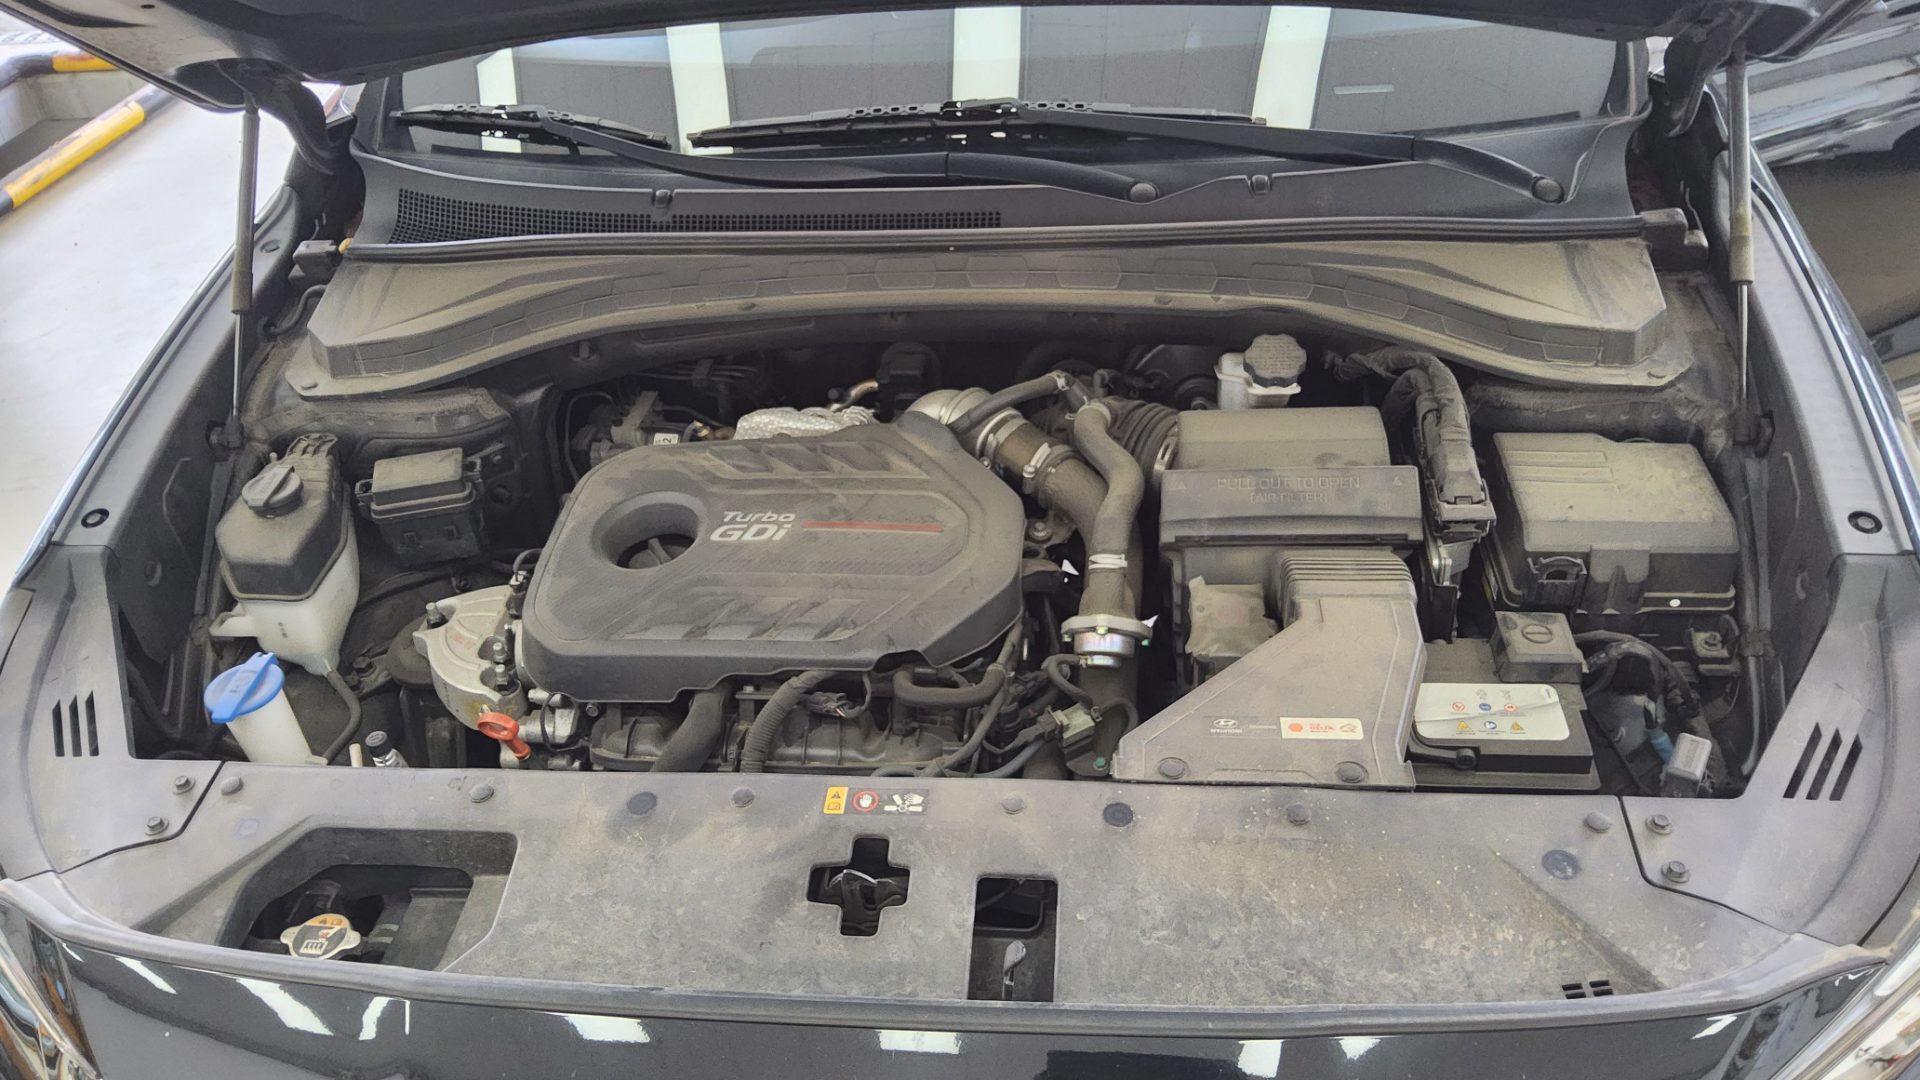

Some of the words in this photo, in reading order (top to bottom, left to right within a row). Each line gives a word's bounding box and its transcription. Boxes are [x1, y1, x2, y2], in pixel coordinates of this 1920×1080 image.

[1217, 477, 1256, 490] PULL
[1259, 477, 1292, 490] OUT
[1296, 477, 1314, 489] TO
[1318, 476, 1360, 489] OPEN
[723, 511, 795, 522] Turbo
[710, 524, 792, 541] GDi
